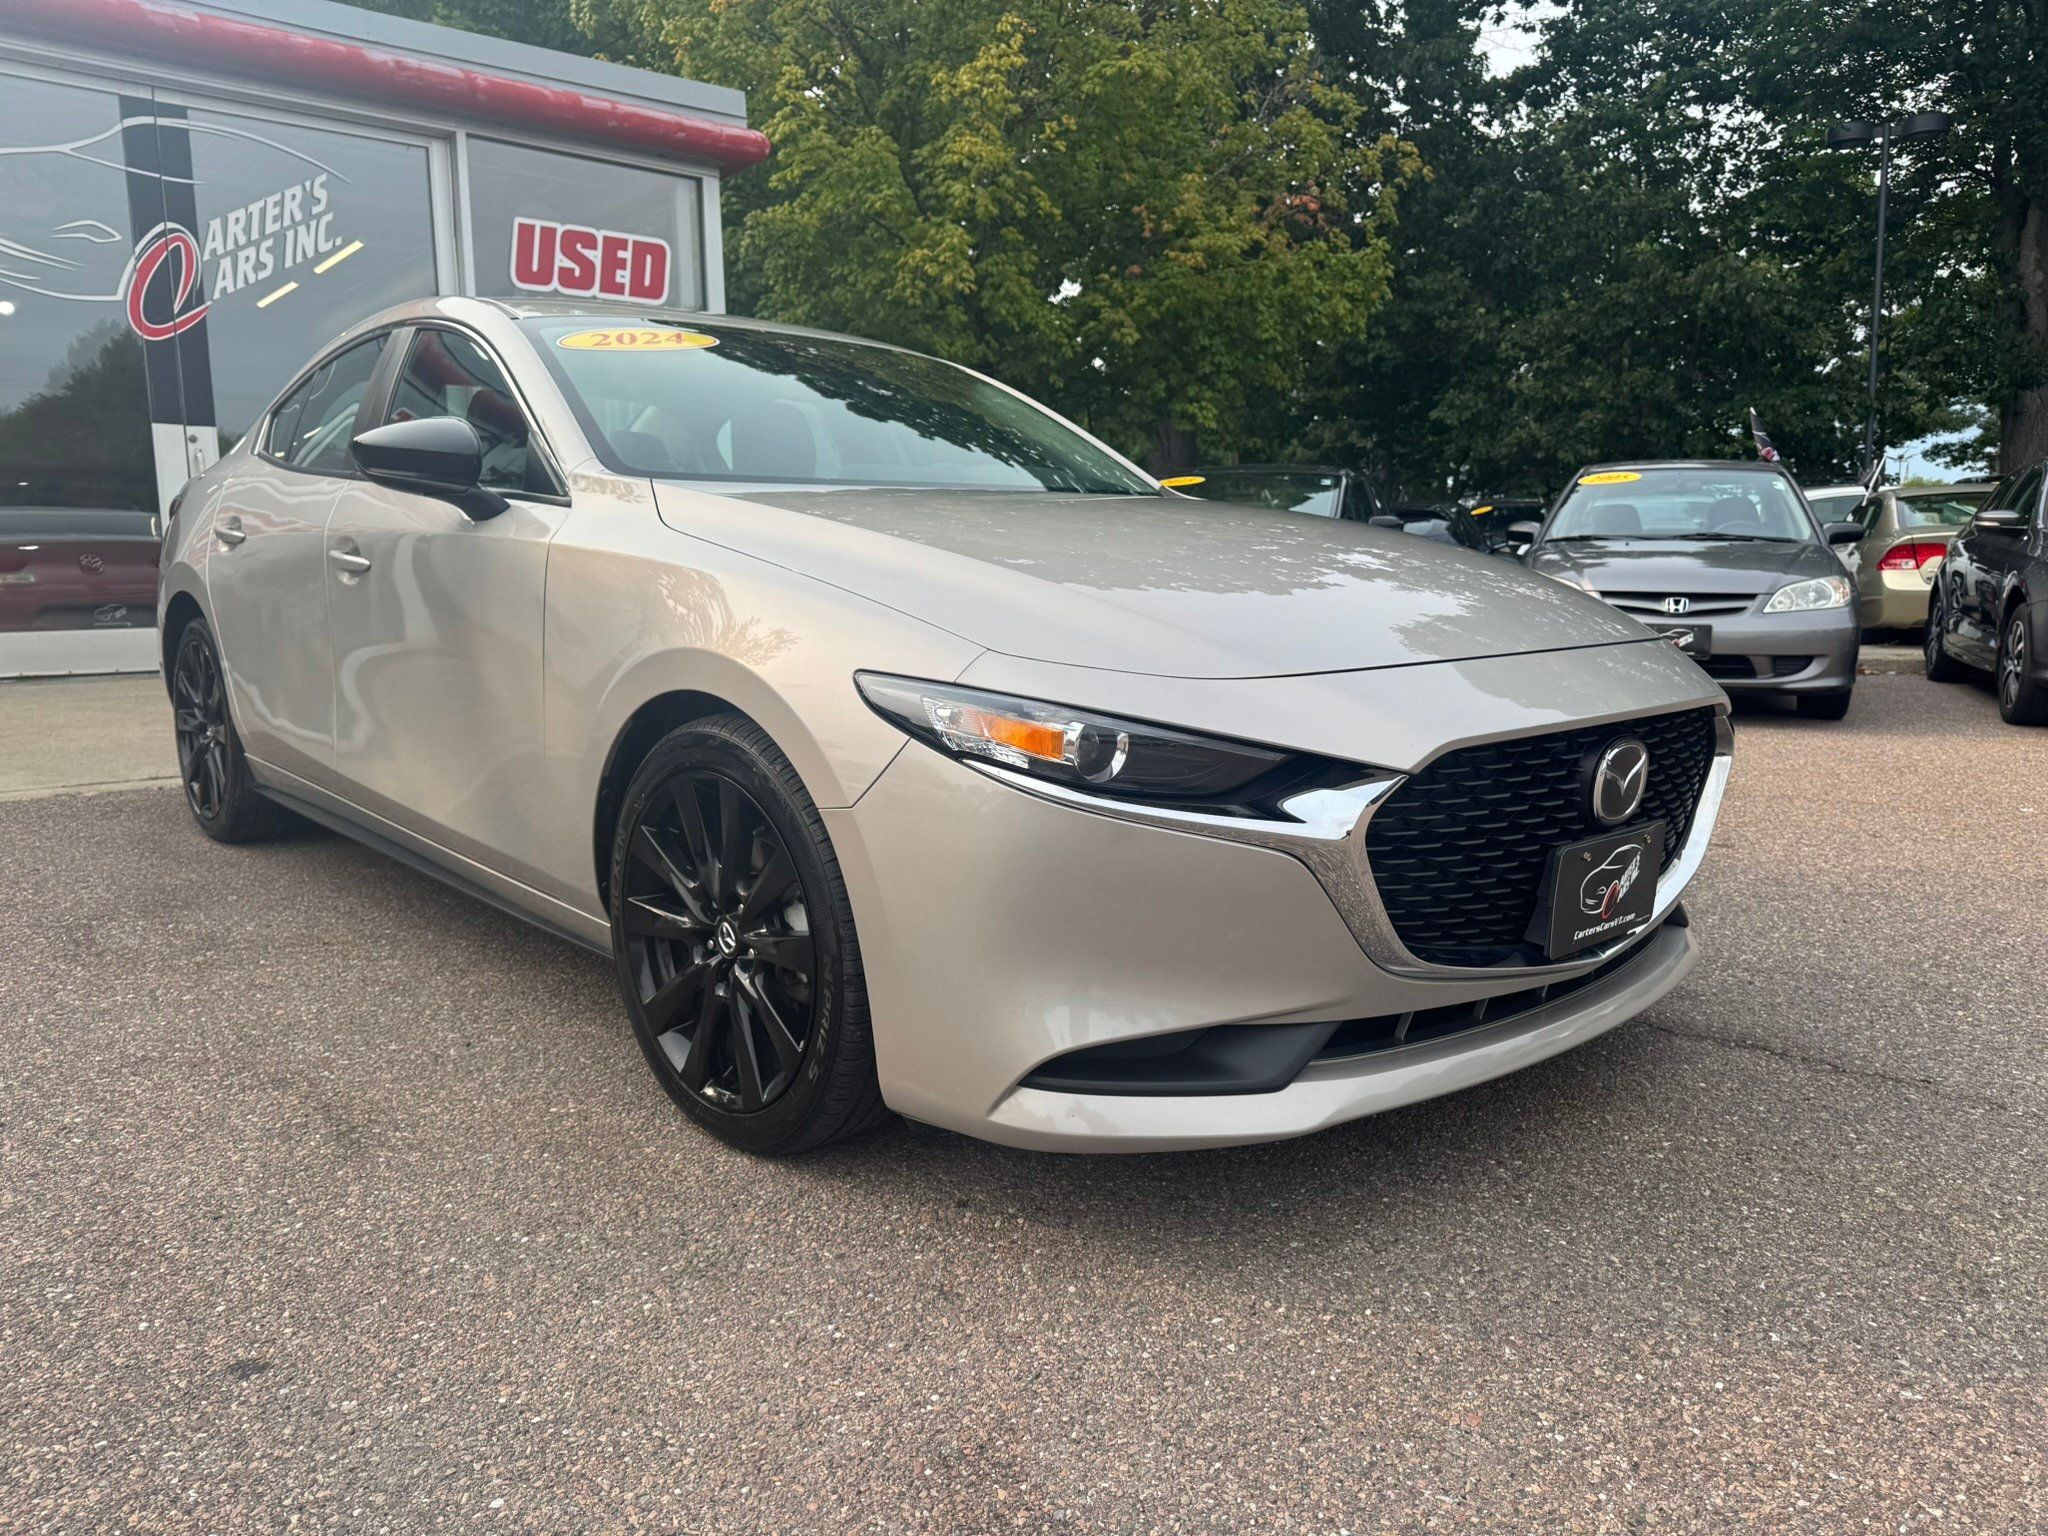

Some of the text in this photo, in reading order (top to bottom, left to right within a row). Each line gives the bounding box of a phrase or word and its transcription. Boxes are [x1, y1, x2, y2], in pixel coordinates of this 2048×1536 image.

[283, 211, 343, 269] INC.
[513, 219, 669, 303] USED
[589, 331, 687, 347] 2024
